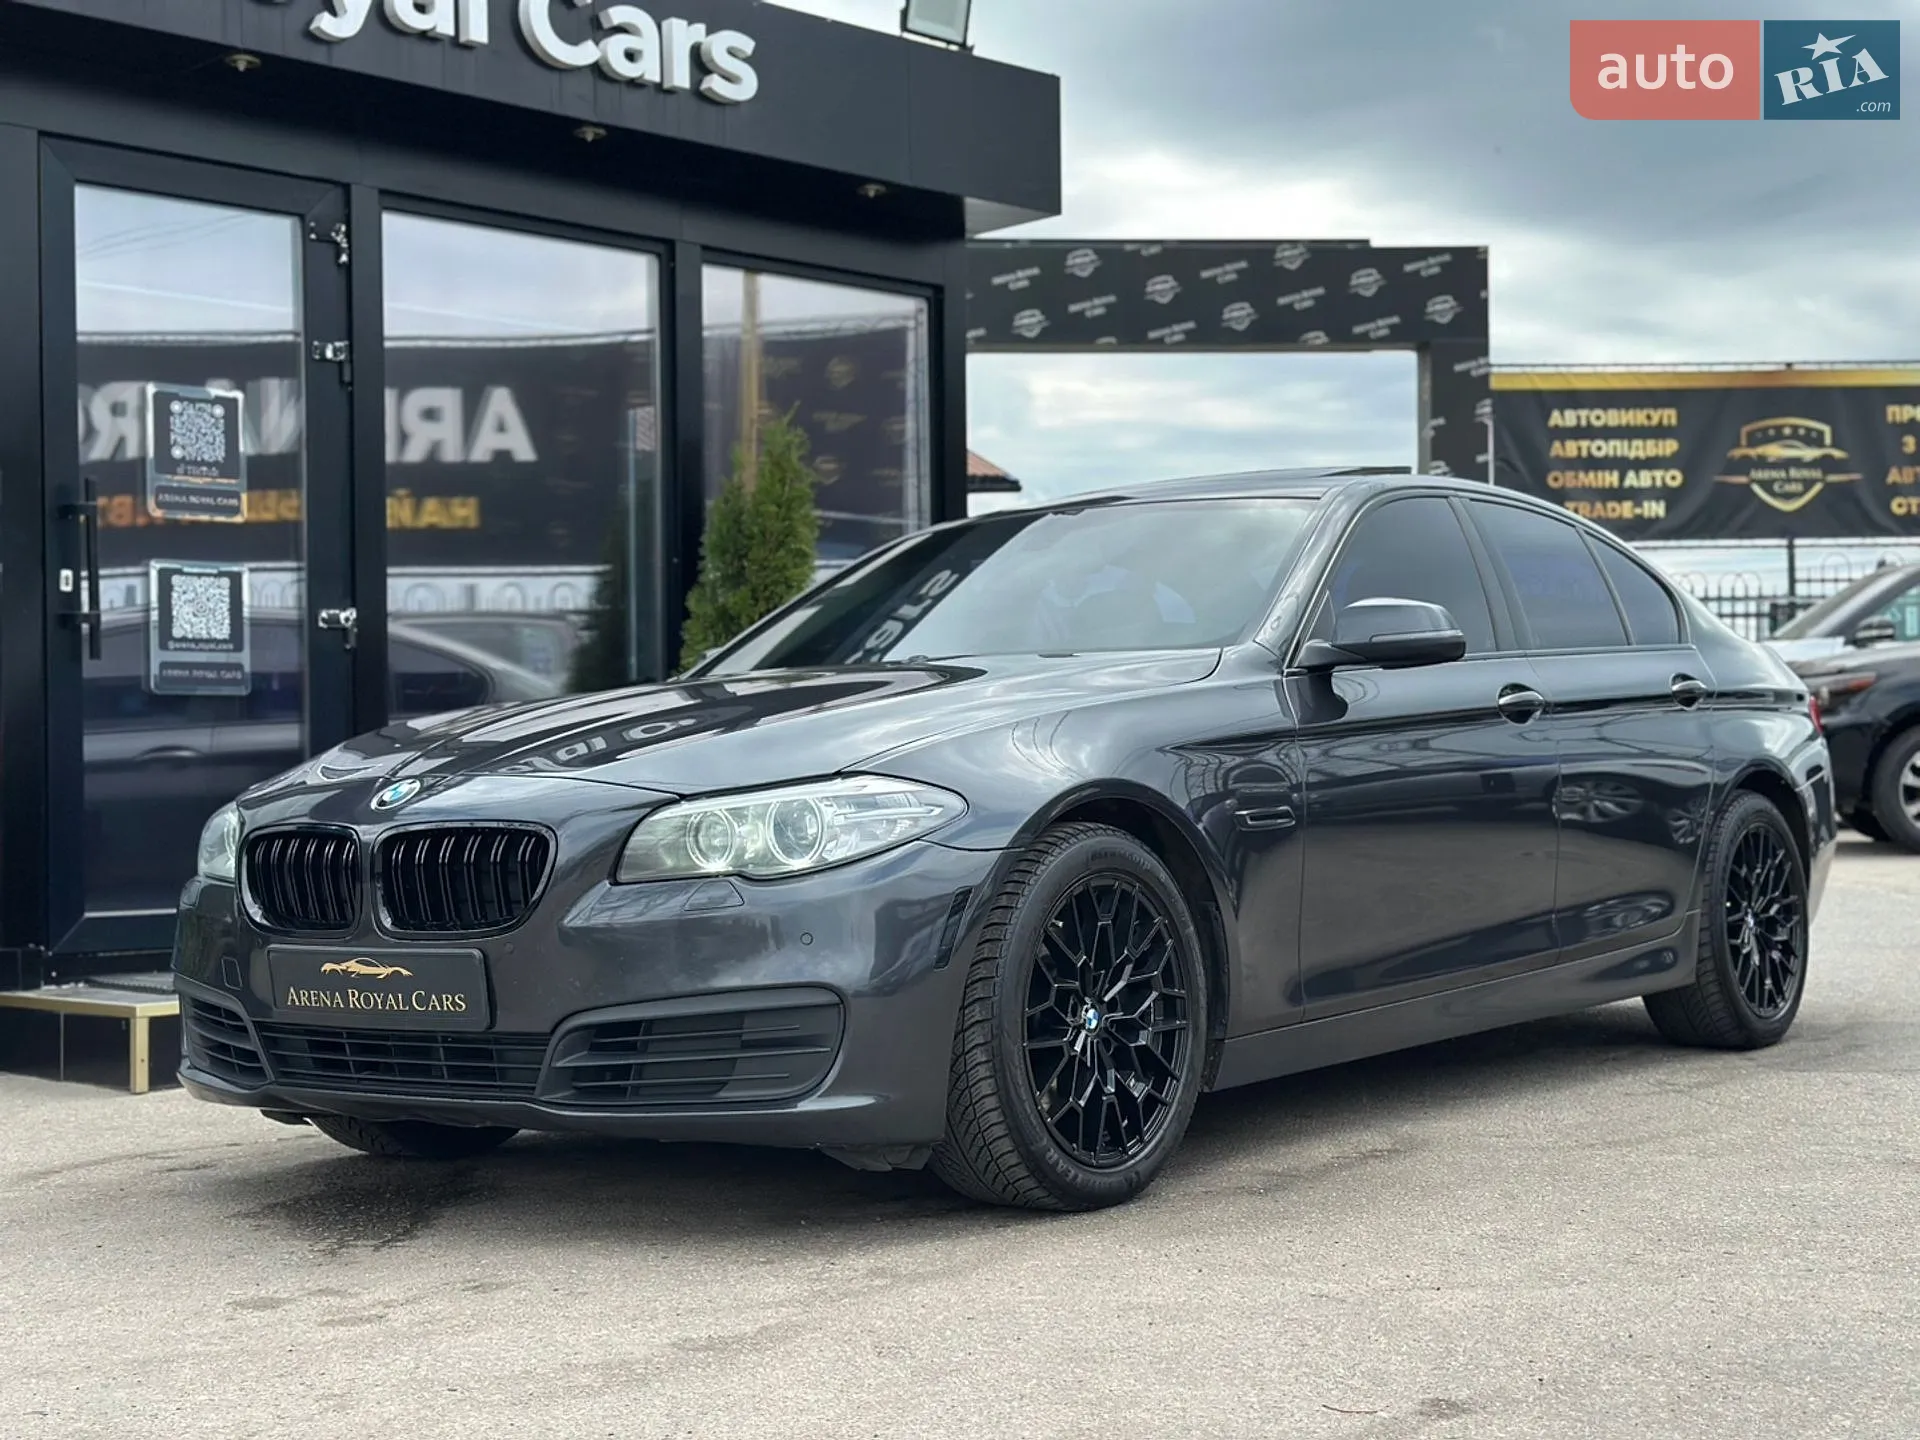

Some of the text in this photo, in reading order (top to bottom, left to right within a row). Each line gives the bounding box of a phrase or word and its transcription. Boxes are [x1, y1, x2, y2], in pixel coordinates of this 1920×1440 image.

[517, 0, 759, 103] Cars
[1548, 407, 1678, 428] АВТОВИКУП
[1550, 437, 1680, 460] АВТОПІДБІР
[1546, 468, 1684, 489] ОБМІН АВТО
[1564, 500, 1667, 519] TRADE-IN
[287, 986, 467, 1012] ARENA ROYAL CARS
